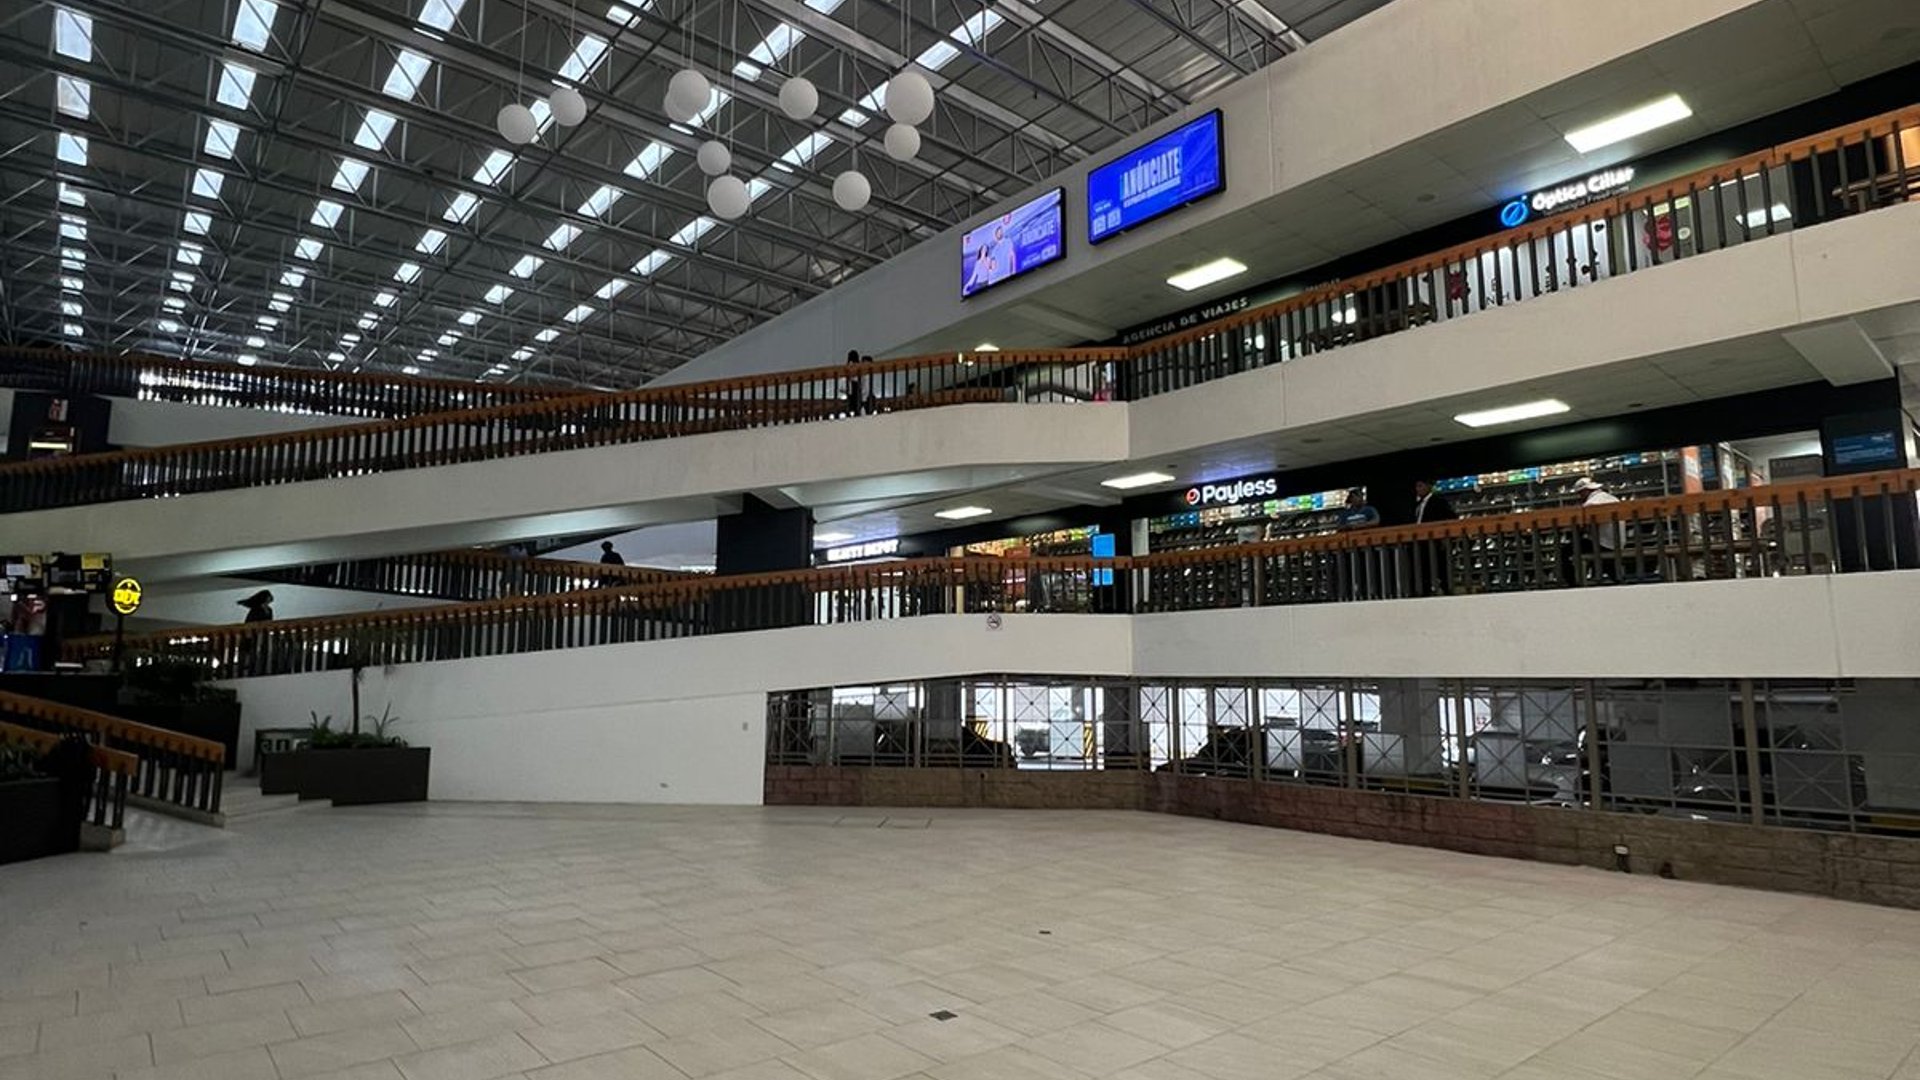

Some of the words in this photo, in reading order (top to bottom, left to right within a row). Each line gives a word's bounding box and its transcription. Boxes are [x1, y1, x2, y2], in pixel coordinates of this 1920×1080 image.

[1122, 321, 1176, 344] AGENCIA
[1180, 313, 1198, 326] DE
[1201, 297, 1248, 319] VIAJES
[1202, 478, 1277, 504] Payless
